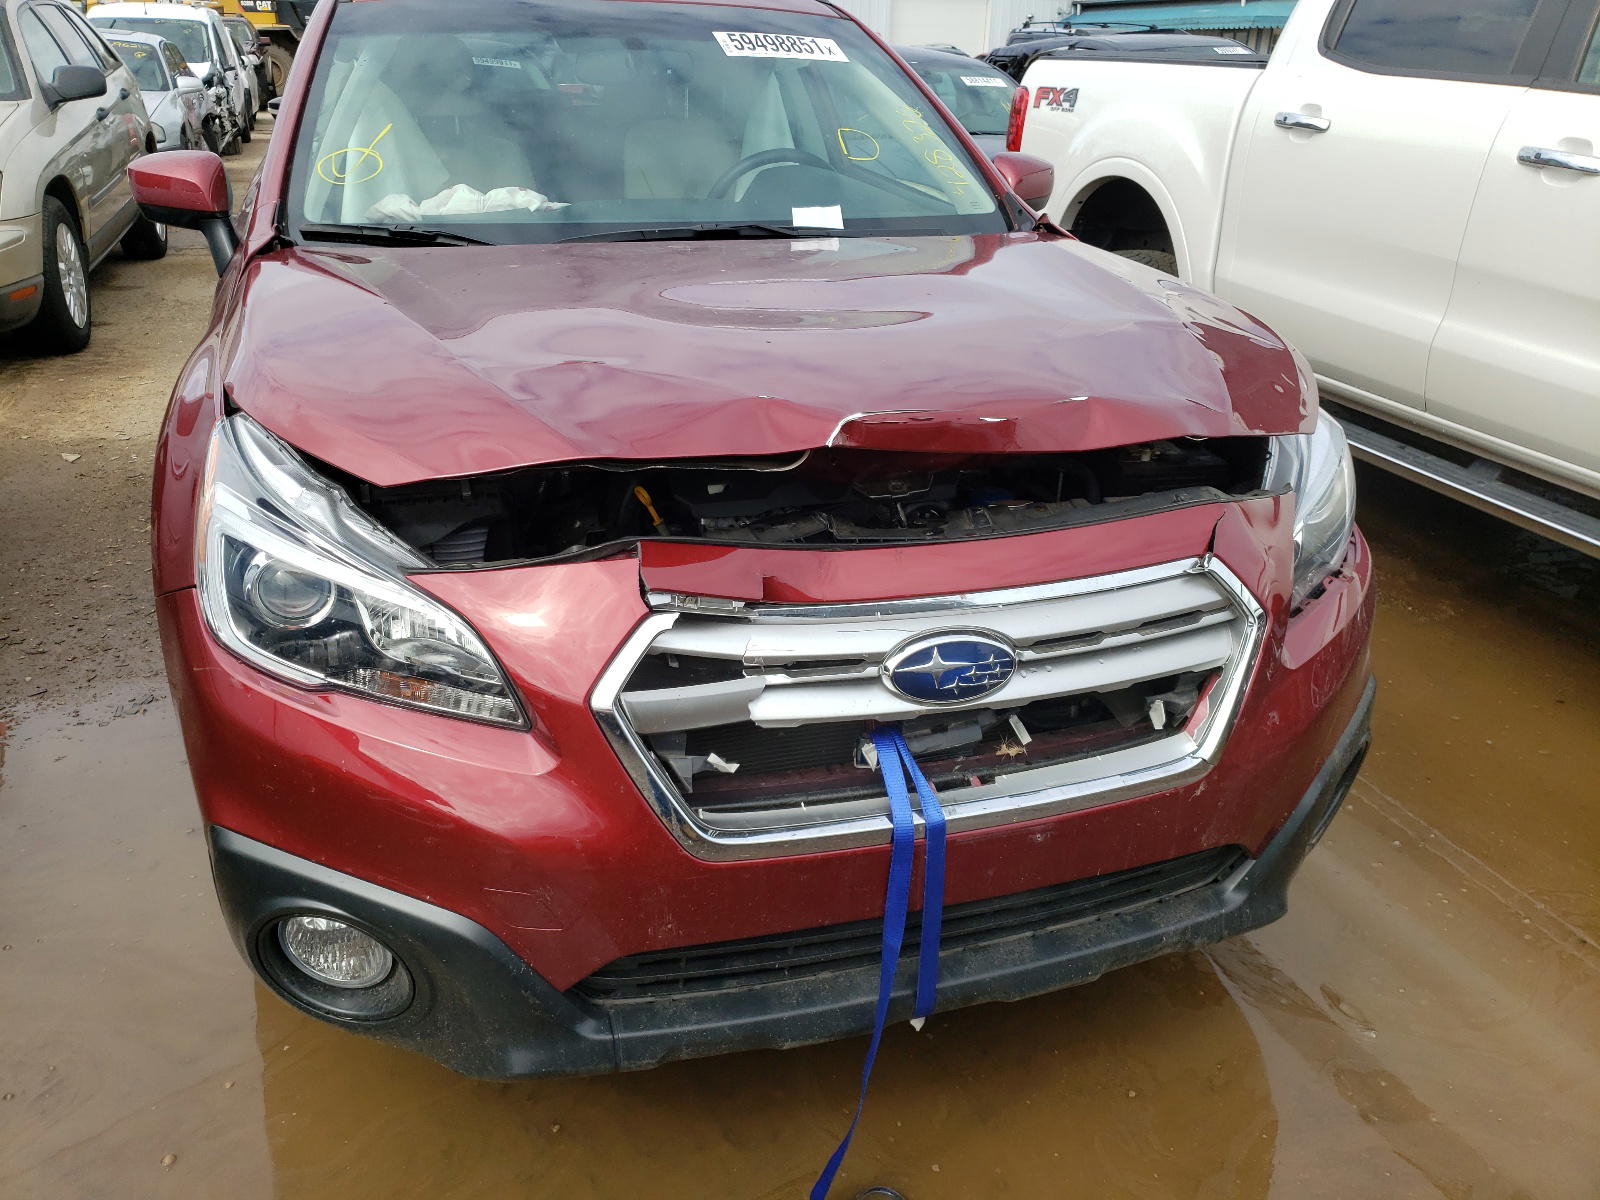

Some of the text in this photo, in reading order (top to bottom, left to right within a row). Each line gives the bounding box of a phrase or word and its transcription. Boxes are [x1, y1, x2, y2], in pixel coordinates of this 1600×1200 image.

[256, 1, 272, 10] CAT
[727, 33, 825, 54] 59498851
[1033, 86, 1079, 108] FX4
